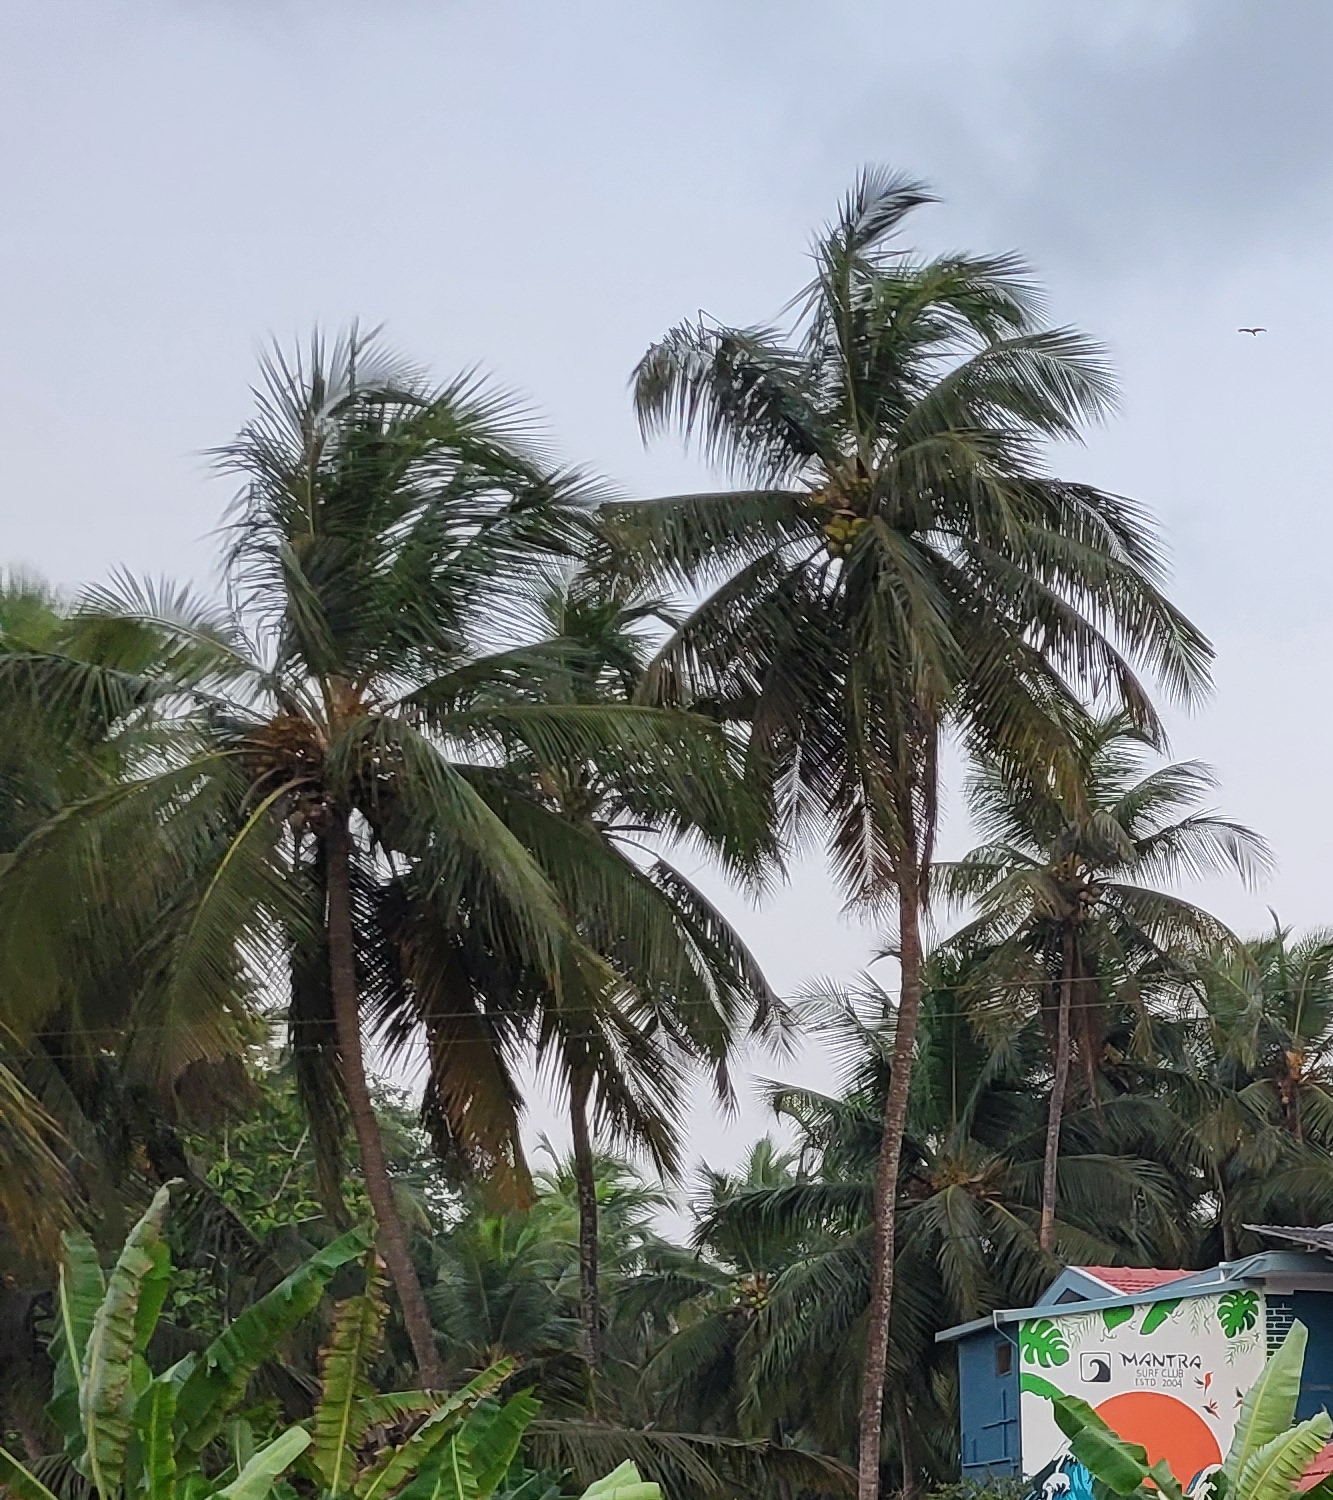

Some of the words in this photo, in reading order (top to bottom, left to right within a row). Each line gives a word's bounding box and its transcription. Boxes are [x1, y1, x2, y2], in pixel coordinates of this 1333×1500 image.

[1119, 1352, 1202, 1369] MANTRA
[1136, 1368, 1160, 1378] SURF
[1161, 1369, 1184, 1379] CLUB
[1135, 1378, 1157, 1387] ESTD
[1162, 1379, 1183, 1388] 2004
